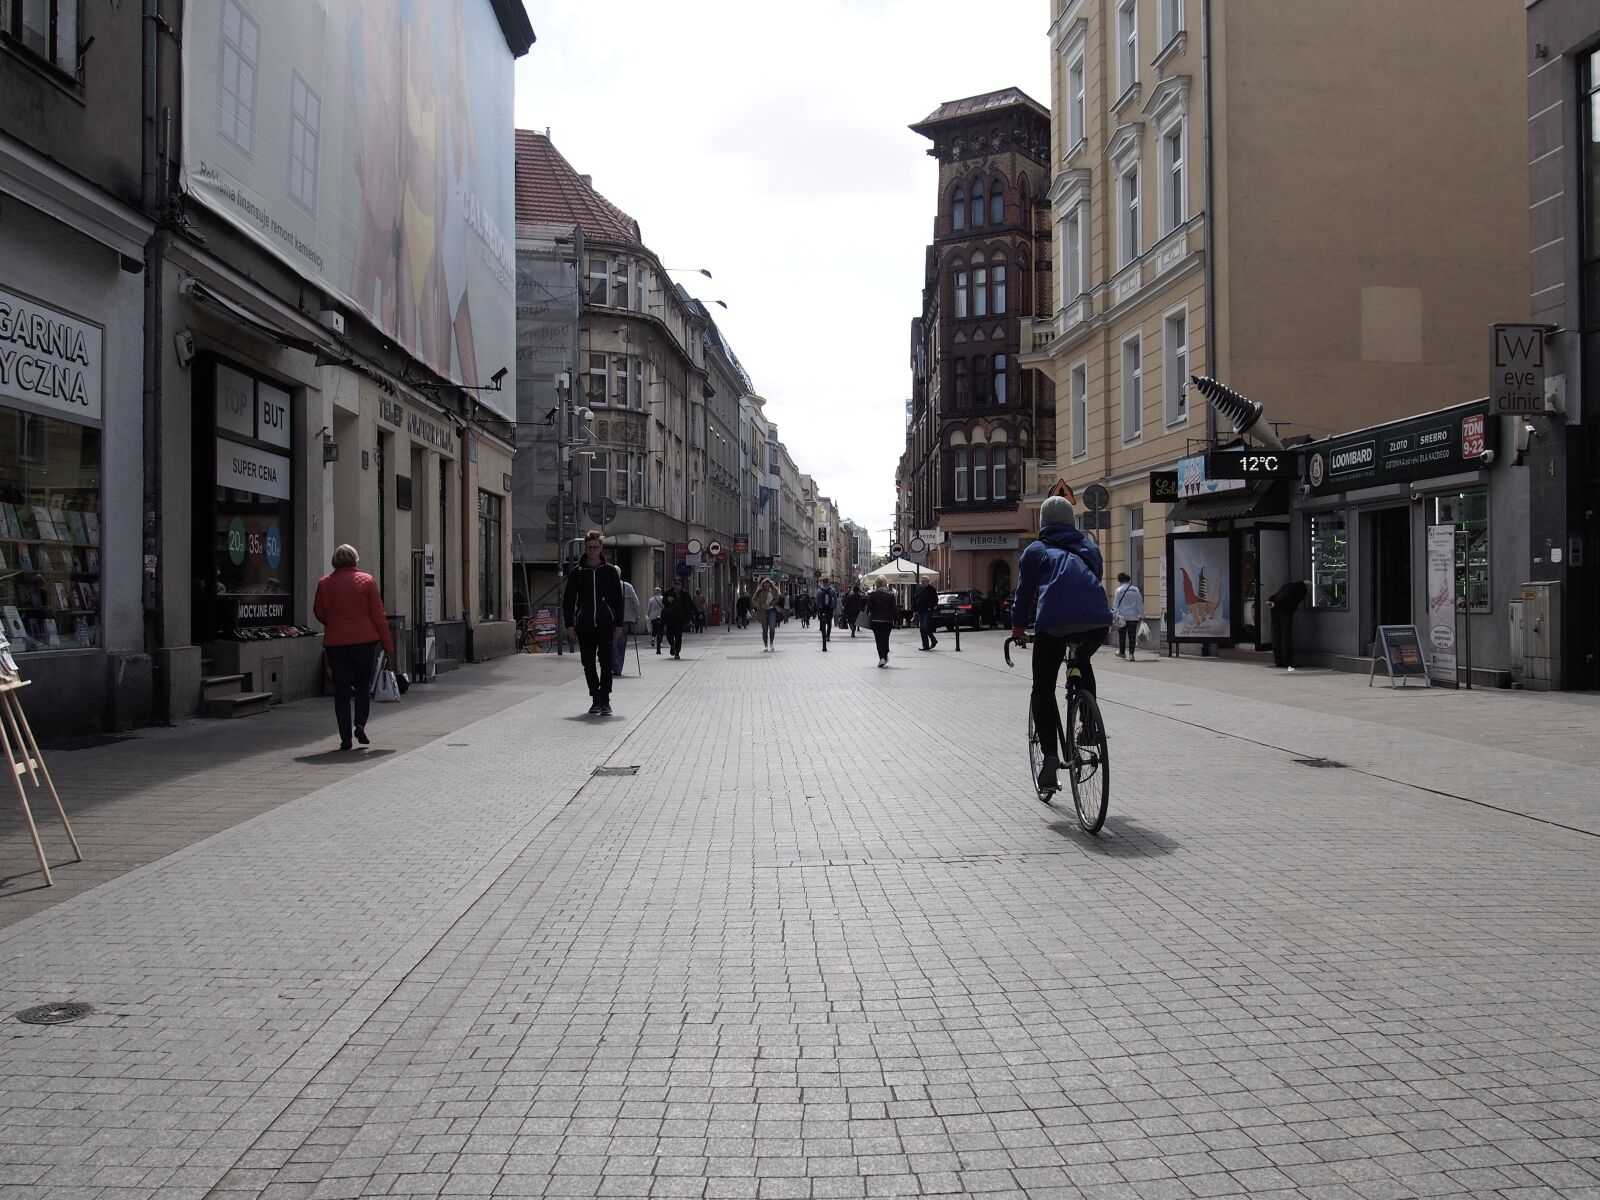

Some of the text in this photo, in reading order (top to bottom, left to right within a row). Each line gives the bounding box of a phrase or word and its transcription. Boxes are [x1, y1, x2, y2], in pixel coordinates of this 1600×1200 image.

[200, 160, 236, 202] Reklama
[237, 189, 270, 229] finansuje
[270, 219, 294, 245] remont
[1504, 371, 1535, 390] eye
[223, 385, 285, 430] TOP BUT
[1498, 392, 1541, 410] clinic
[1419, 430, 1448, 445] SREBRO
[1239, 456, 1278, 471] 12°C
[1332, 447, 1373, 469] LOOMBARD
[1546, 458, 1555, 477] 4
[232, 457, 278, 483] SUPER CENA
[268, 602, 284, 617] CENY
